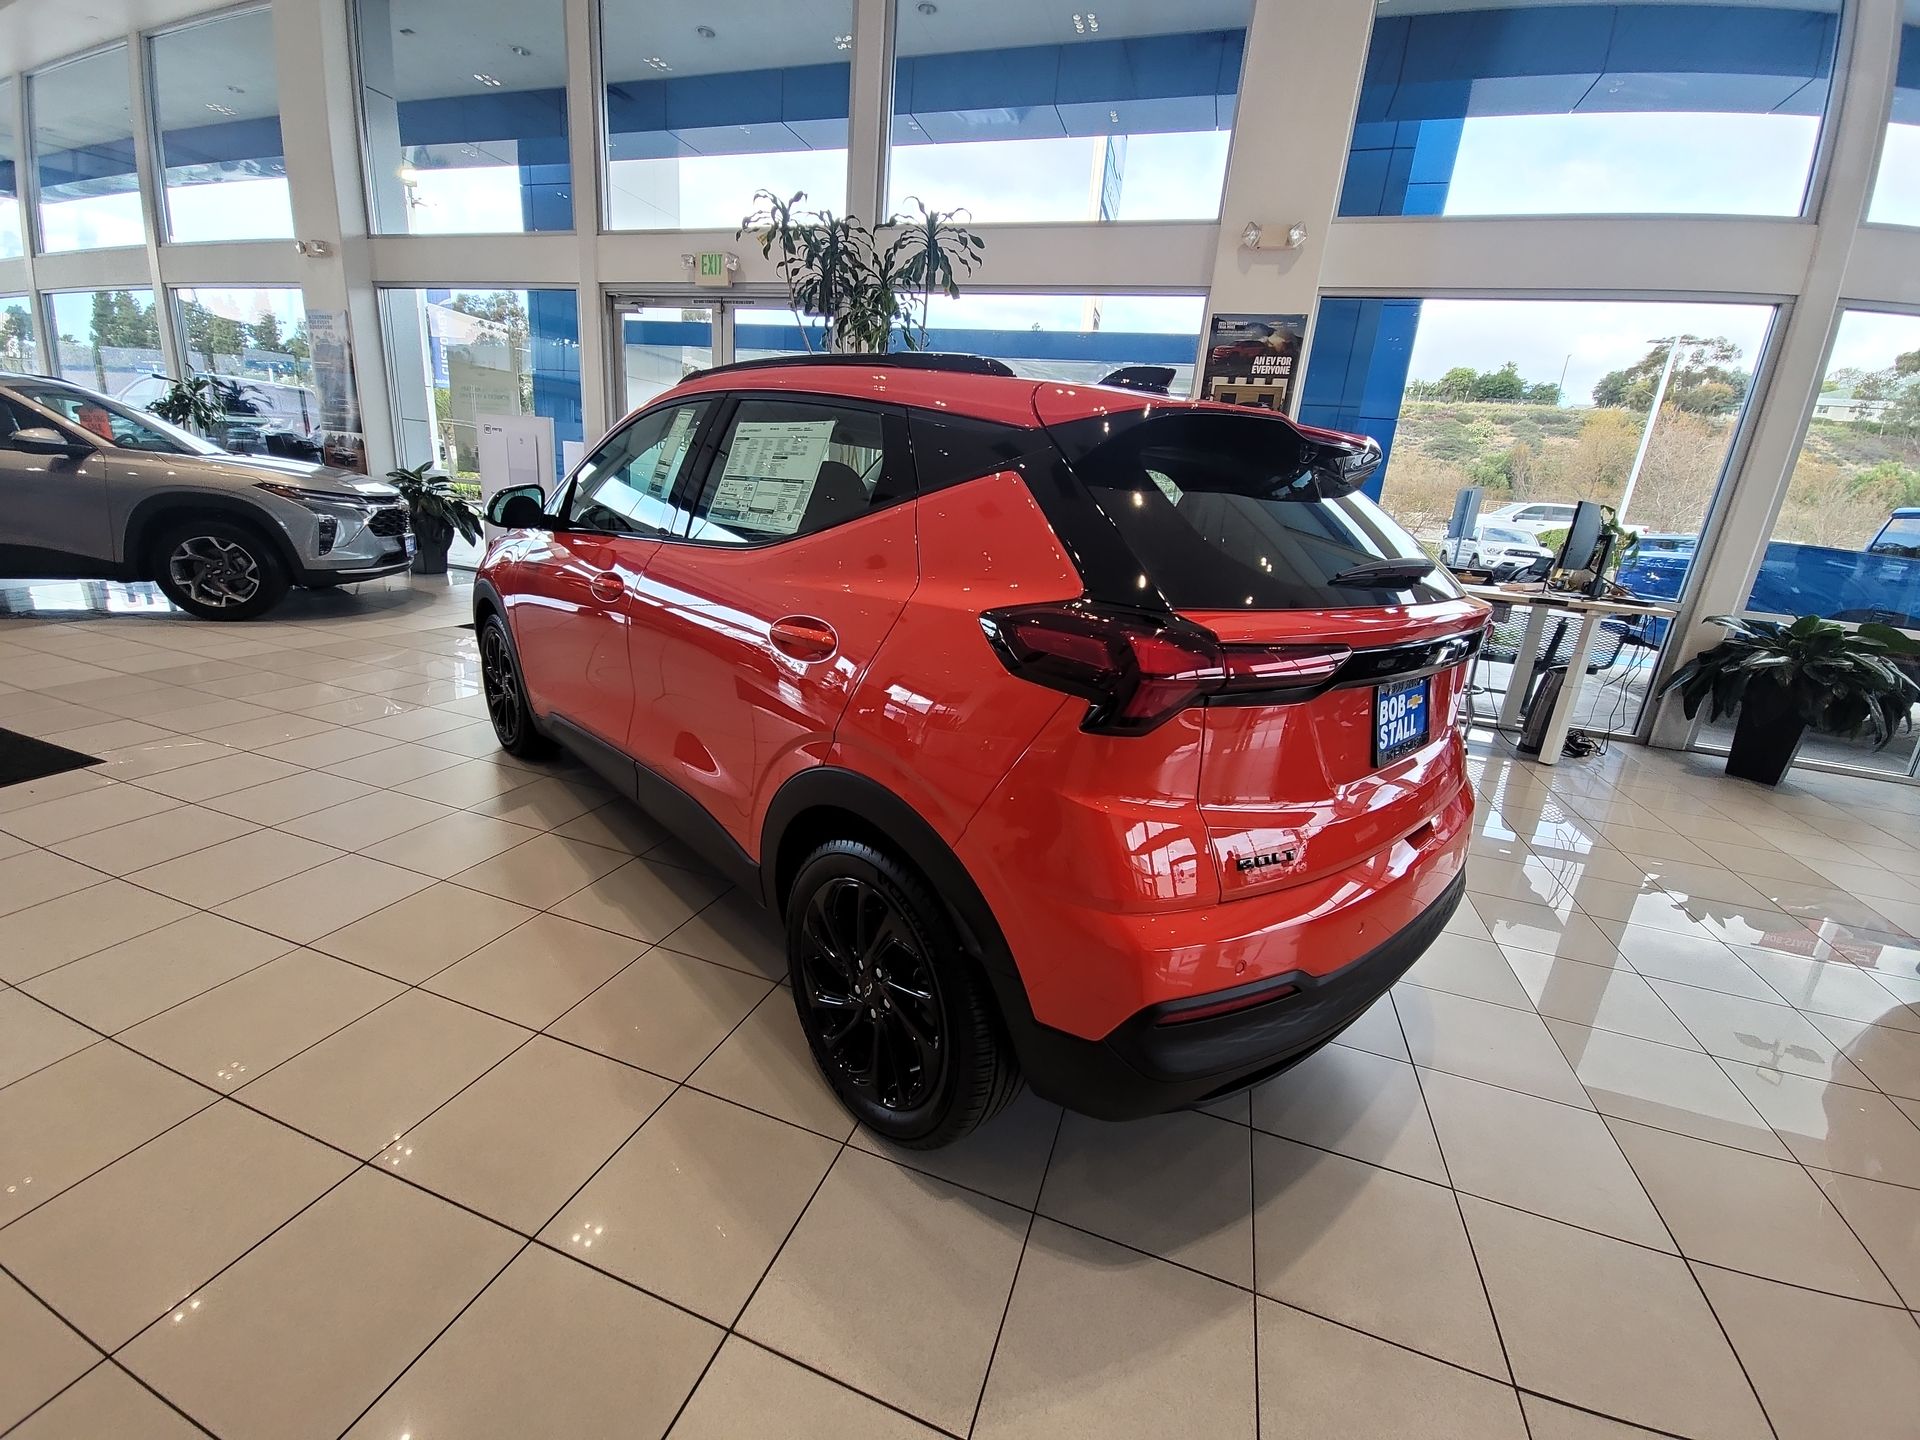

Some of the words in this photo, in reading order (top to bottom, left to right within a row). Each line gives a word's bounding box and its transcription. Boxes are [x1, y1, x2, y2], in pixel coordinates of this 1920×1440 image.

[701, 254, 722, 275] EXIT
[1251, 365, 1291, 375] EVERYONE
[1254, 356, 1267, 366] AN
[1267, 356, 1277, 366] EV
[1277, 356, 1292, 366] FOR
[1379, 694, 1406, 725] BOB
[1379, 714, 1417, 750] STALL
[1236, 849, 1297, 871] BOLT
